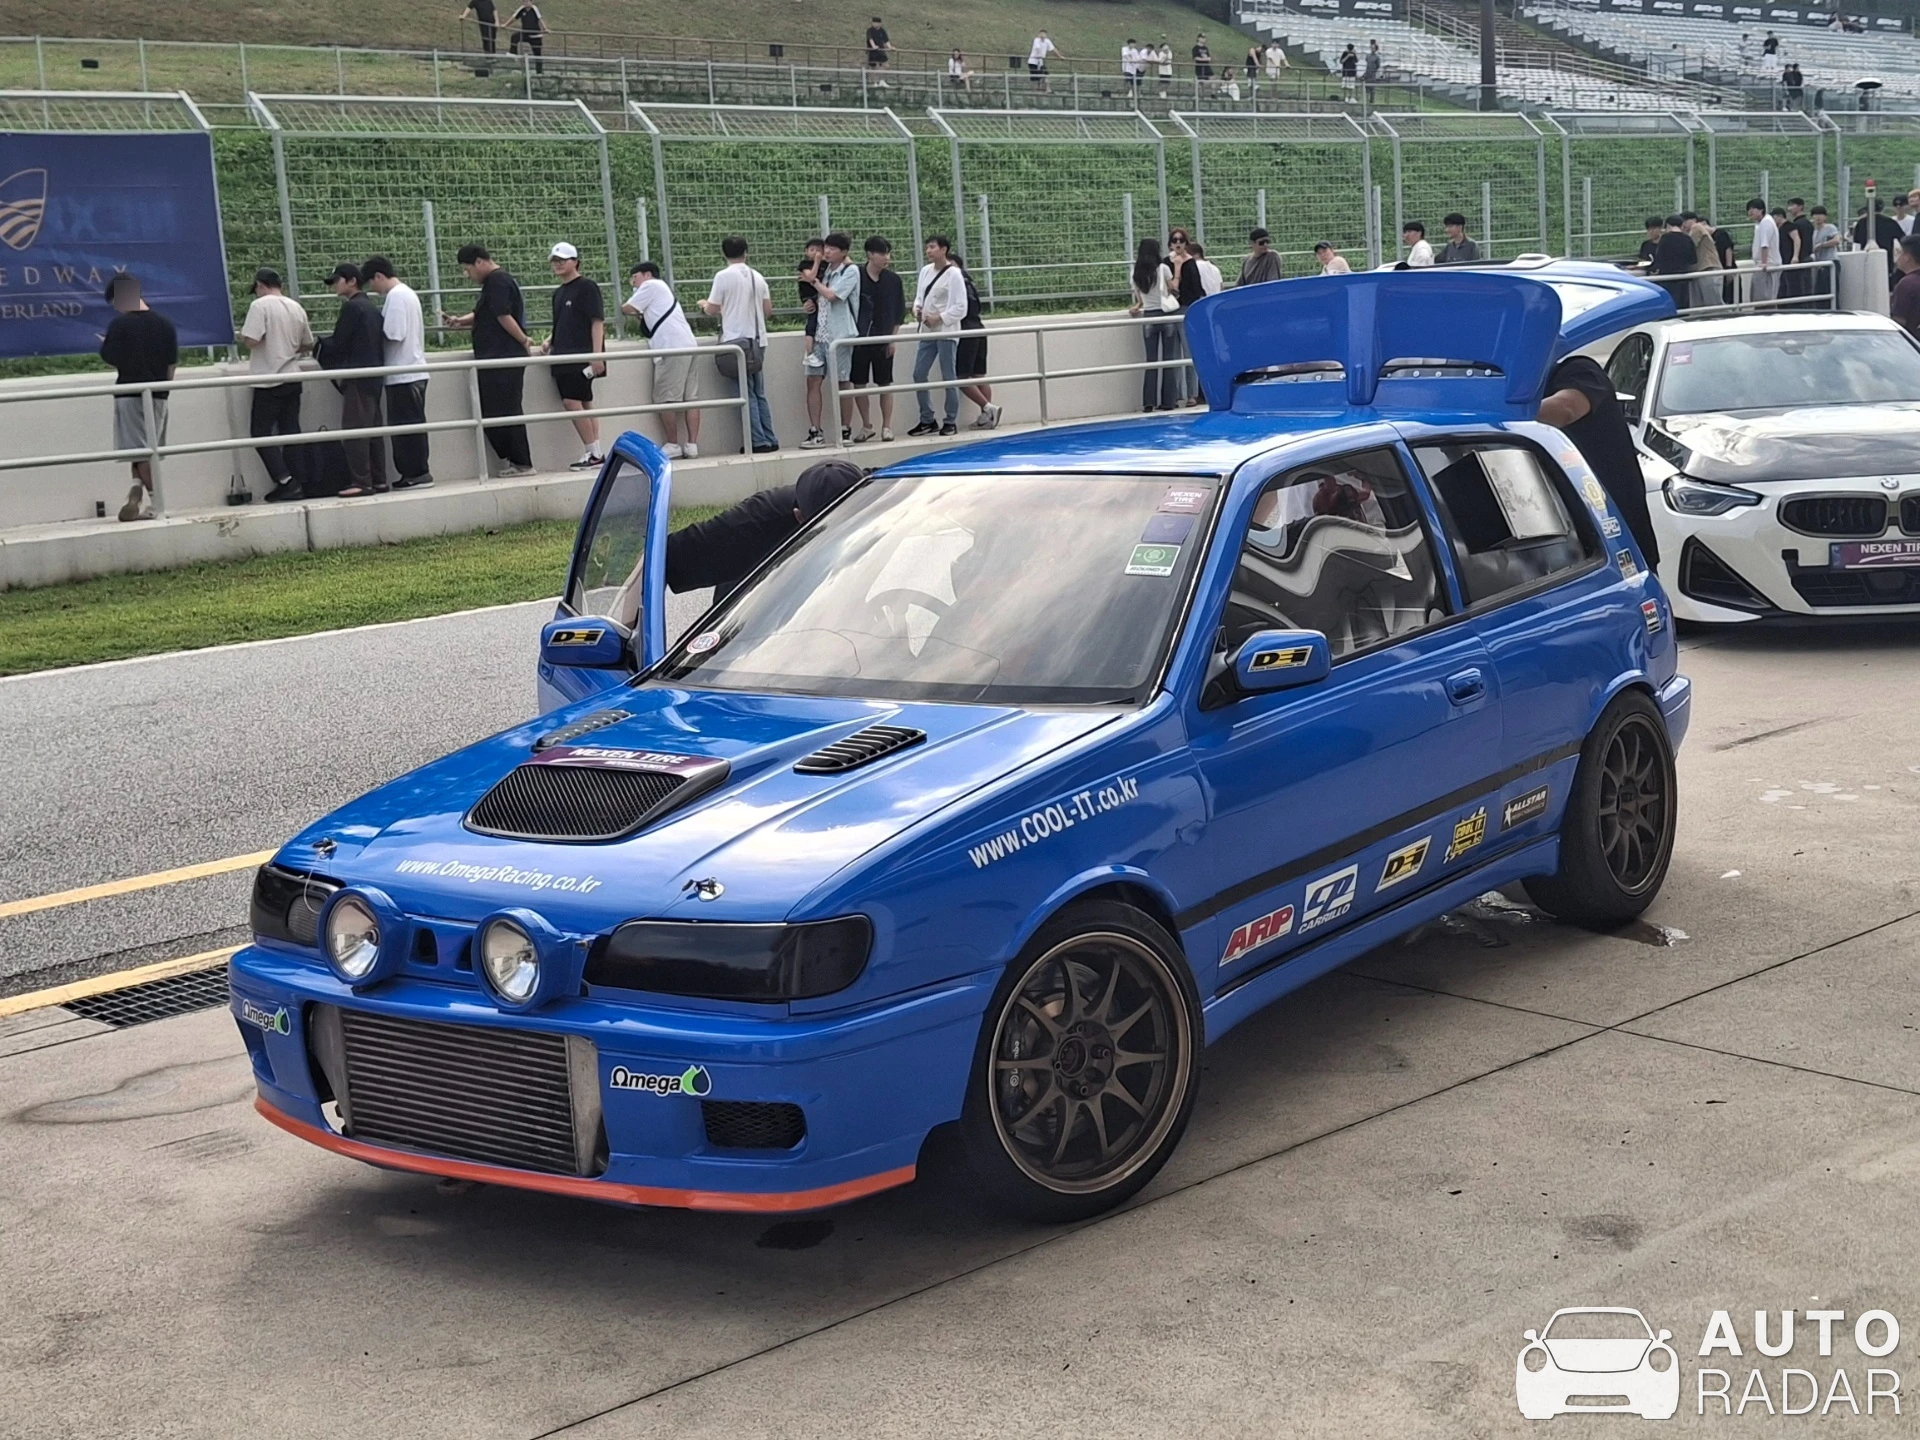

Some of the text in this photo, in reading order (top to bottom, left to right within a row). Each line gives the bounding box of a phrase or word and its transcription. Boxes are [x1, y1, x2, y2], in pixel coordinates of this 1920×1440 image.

[1860, 543, 1902, 554] NEXEN
[568, 748, 691, 764] NEXEN TIRE
[1511, 790, 1547, 813] ALLSTAR
[968, 776, 1140, 869] www.COOL-IT.co.kr
[394, 859, 602, 893] www.OmegaRacing.co.kr
[1223, 906, 1294, 960] ARP
[1298, 903, 1351, 935] CARRILLO
